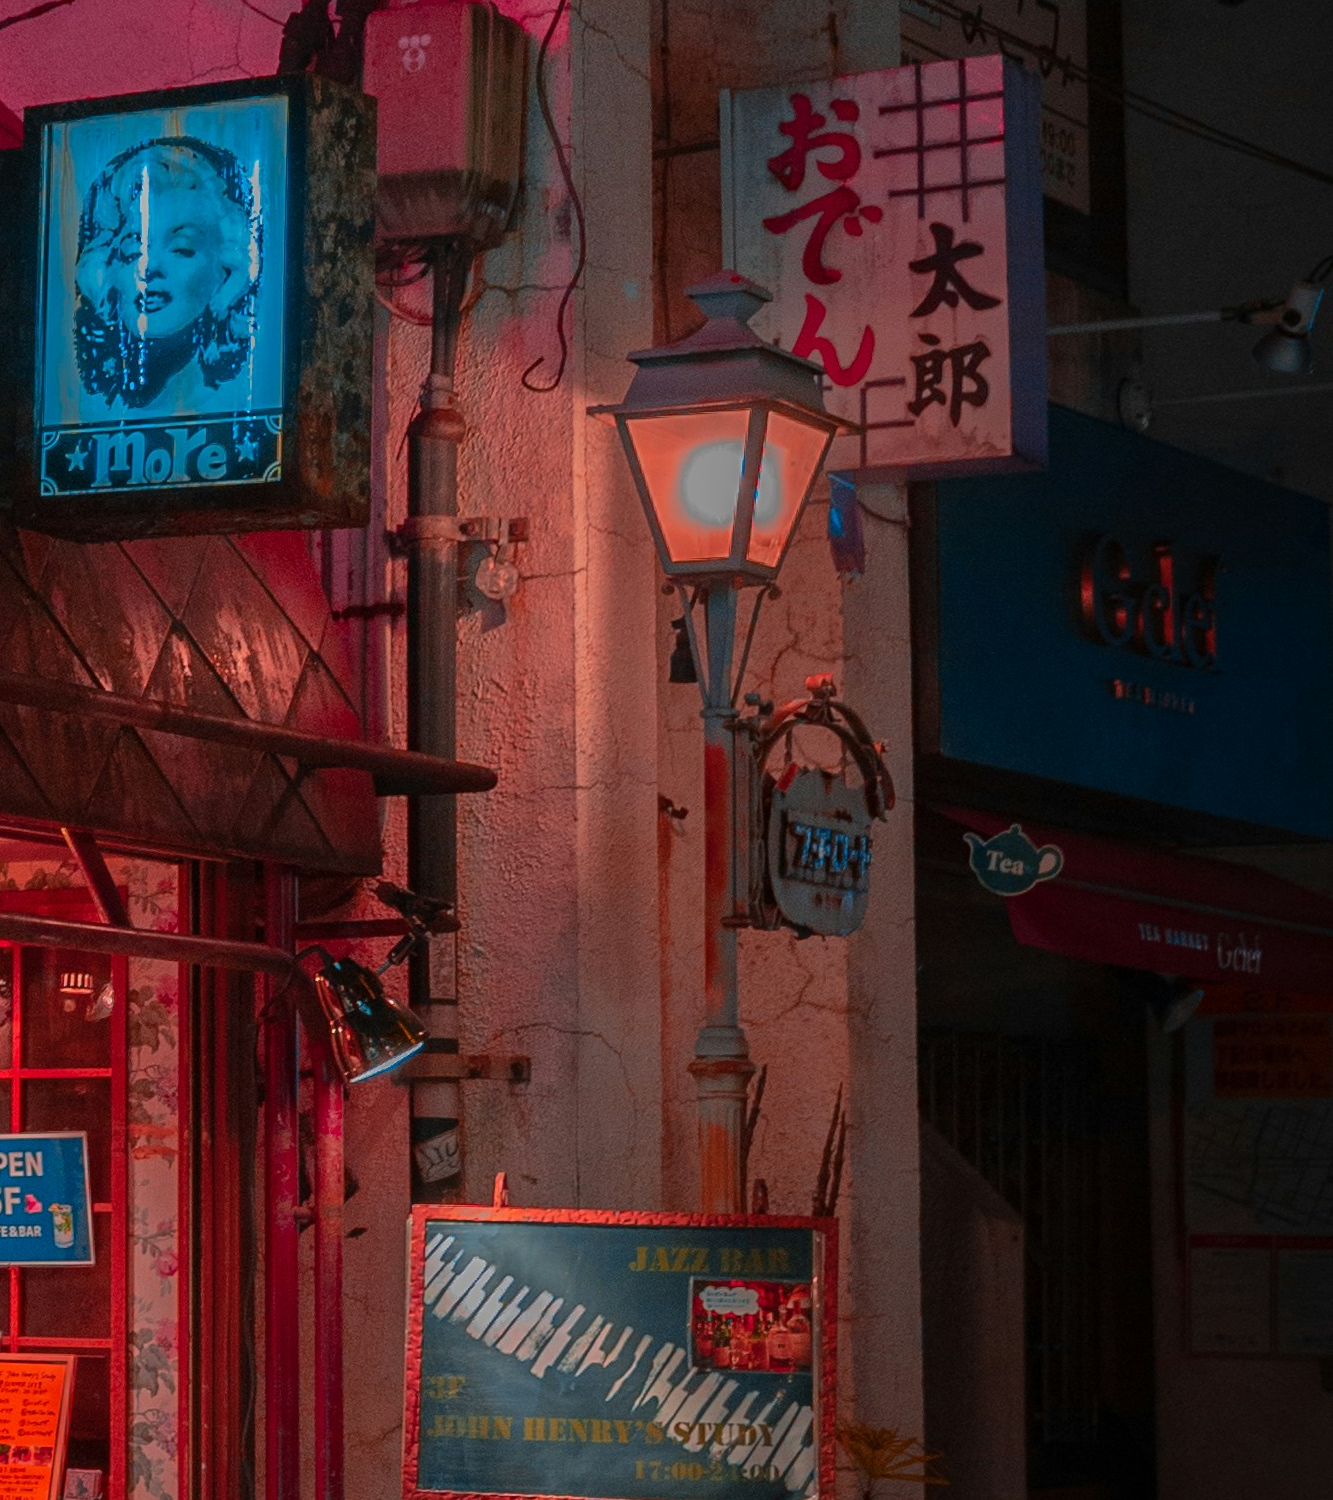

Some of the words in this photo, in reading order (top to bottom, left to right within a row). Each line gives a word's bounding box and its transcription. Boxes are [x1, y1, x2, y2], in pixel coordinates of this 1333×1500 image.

[764, 92, 883, 387] おでん
[907, 220, 1003, 430] 太郎
[985, 849, 1025, 877] Tea
[1137, 922, 1162, 943] TEA
[628, 1245, 710, 1274] JAZZ
[719, 1248, 791, 1274] BAR
[427, 1375, 466, 1400] 3F
[427, 1415, 513, 1441] JOHN
[523, 1416, 665, 1446] HENRY'S
[672, 1422, 775, 1448] STUDY
